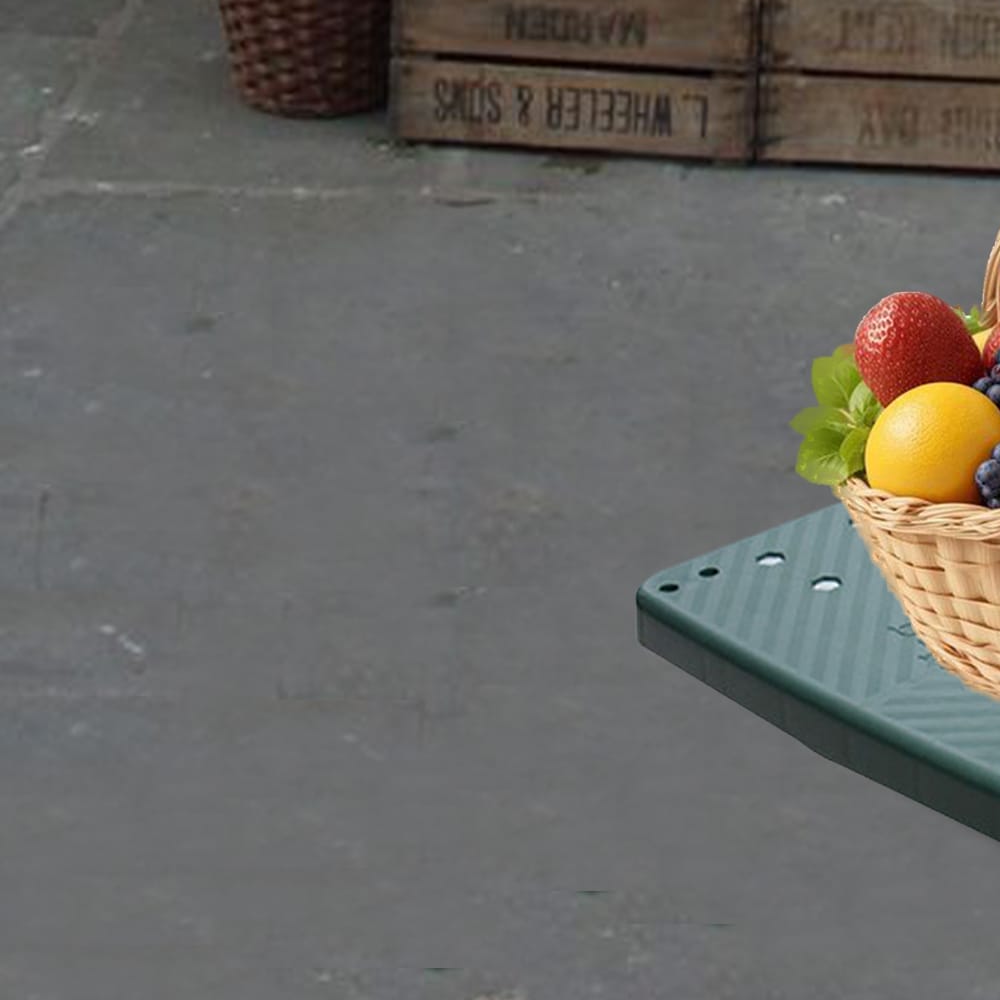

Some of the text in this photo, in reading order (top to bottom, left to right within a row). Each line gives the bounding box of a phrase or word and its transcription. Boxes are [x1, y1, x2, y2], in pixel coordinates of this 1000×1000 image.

[504, 4, 647, 47] MARDEN
[434, 76, 502, 126] SONS
[517, 84, 534, 126] &
[546, 87, 674, 138] WHEELER
